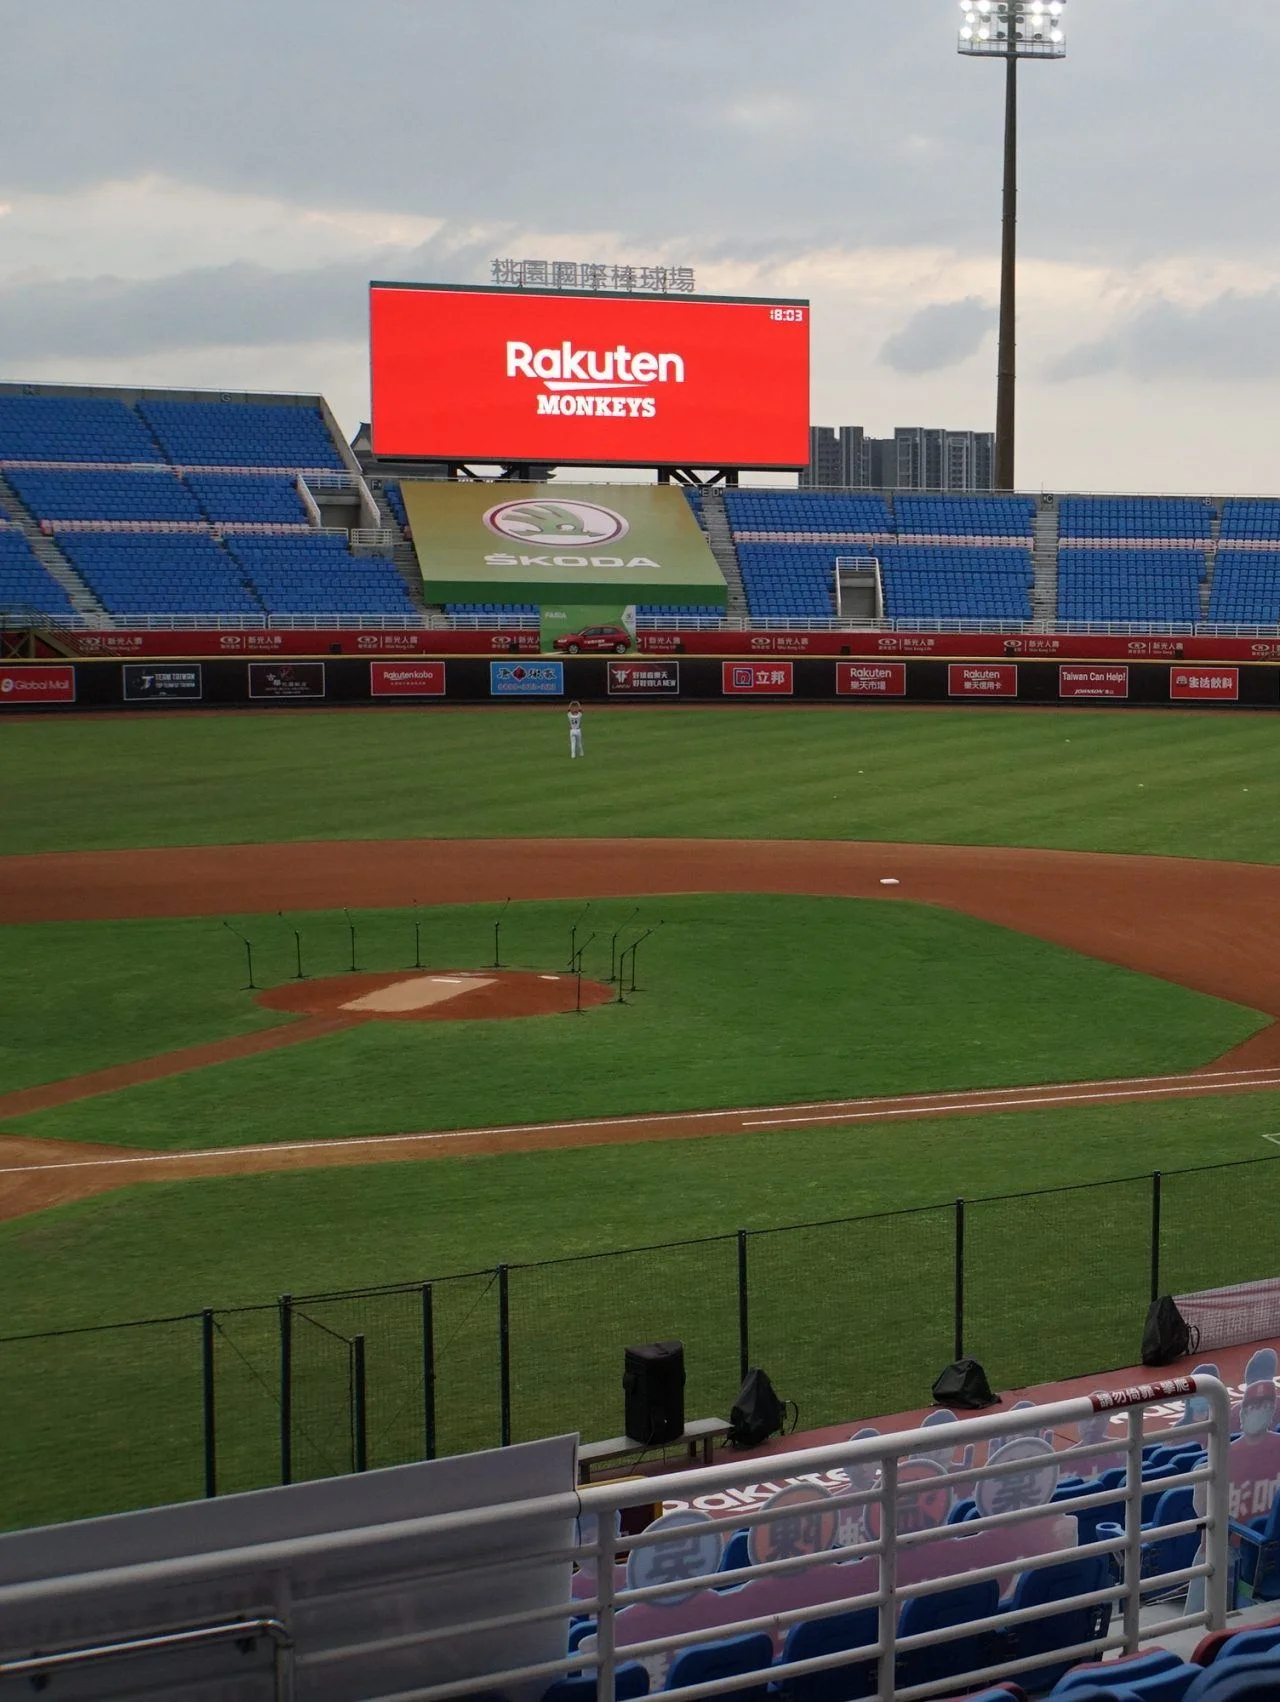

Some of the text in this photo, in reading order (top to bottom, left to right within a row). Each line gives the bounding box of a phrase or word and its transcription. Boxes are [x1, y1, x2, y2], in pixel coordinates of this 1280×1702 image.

[491, 258, 696, 293] 桃園國際棒球場
[769, 308, 803, 322] 18:03
[506, 341, 684, 382] Rakuten
[536, 394, 656, 418] MONKEYS
[483, 553, 662, 569] ŠKODA
[383, 670, 433, 680] Rakuten kobo
[756, 670, 785, 685] 立邦
[850, 668, 892, 678] Rakuten
[963, 669, 1000, 679] Rakuten
[1062, 671, 1126, 683] Taiwan Can Help!
[850, 680, 886, 690] 樂天市場
